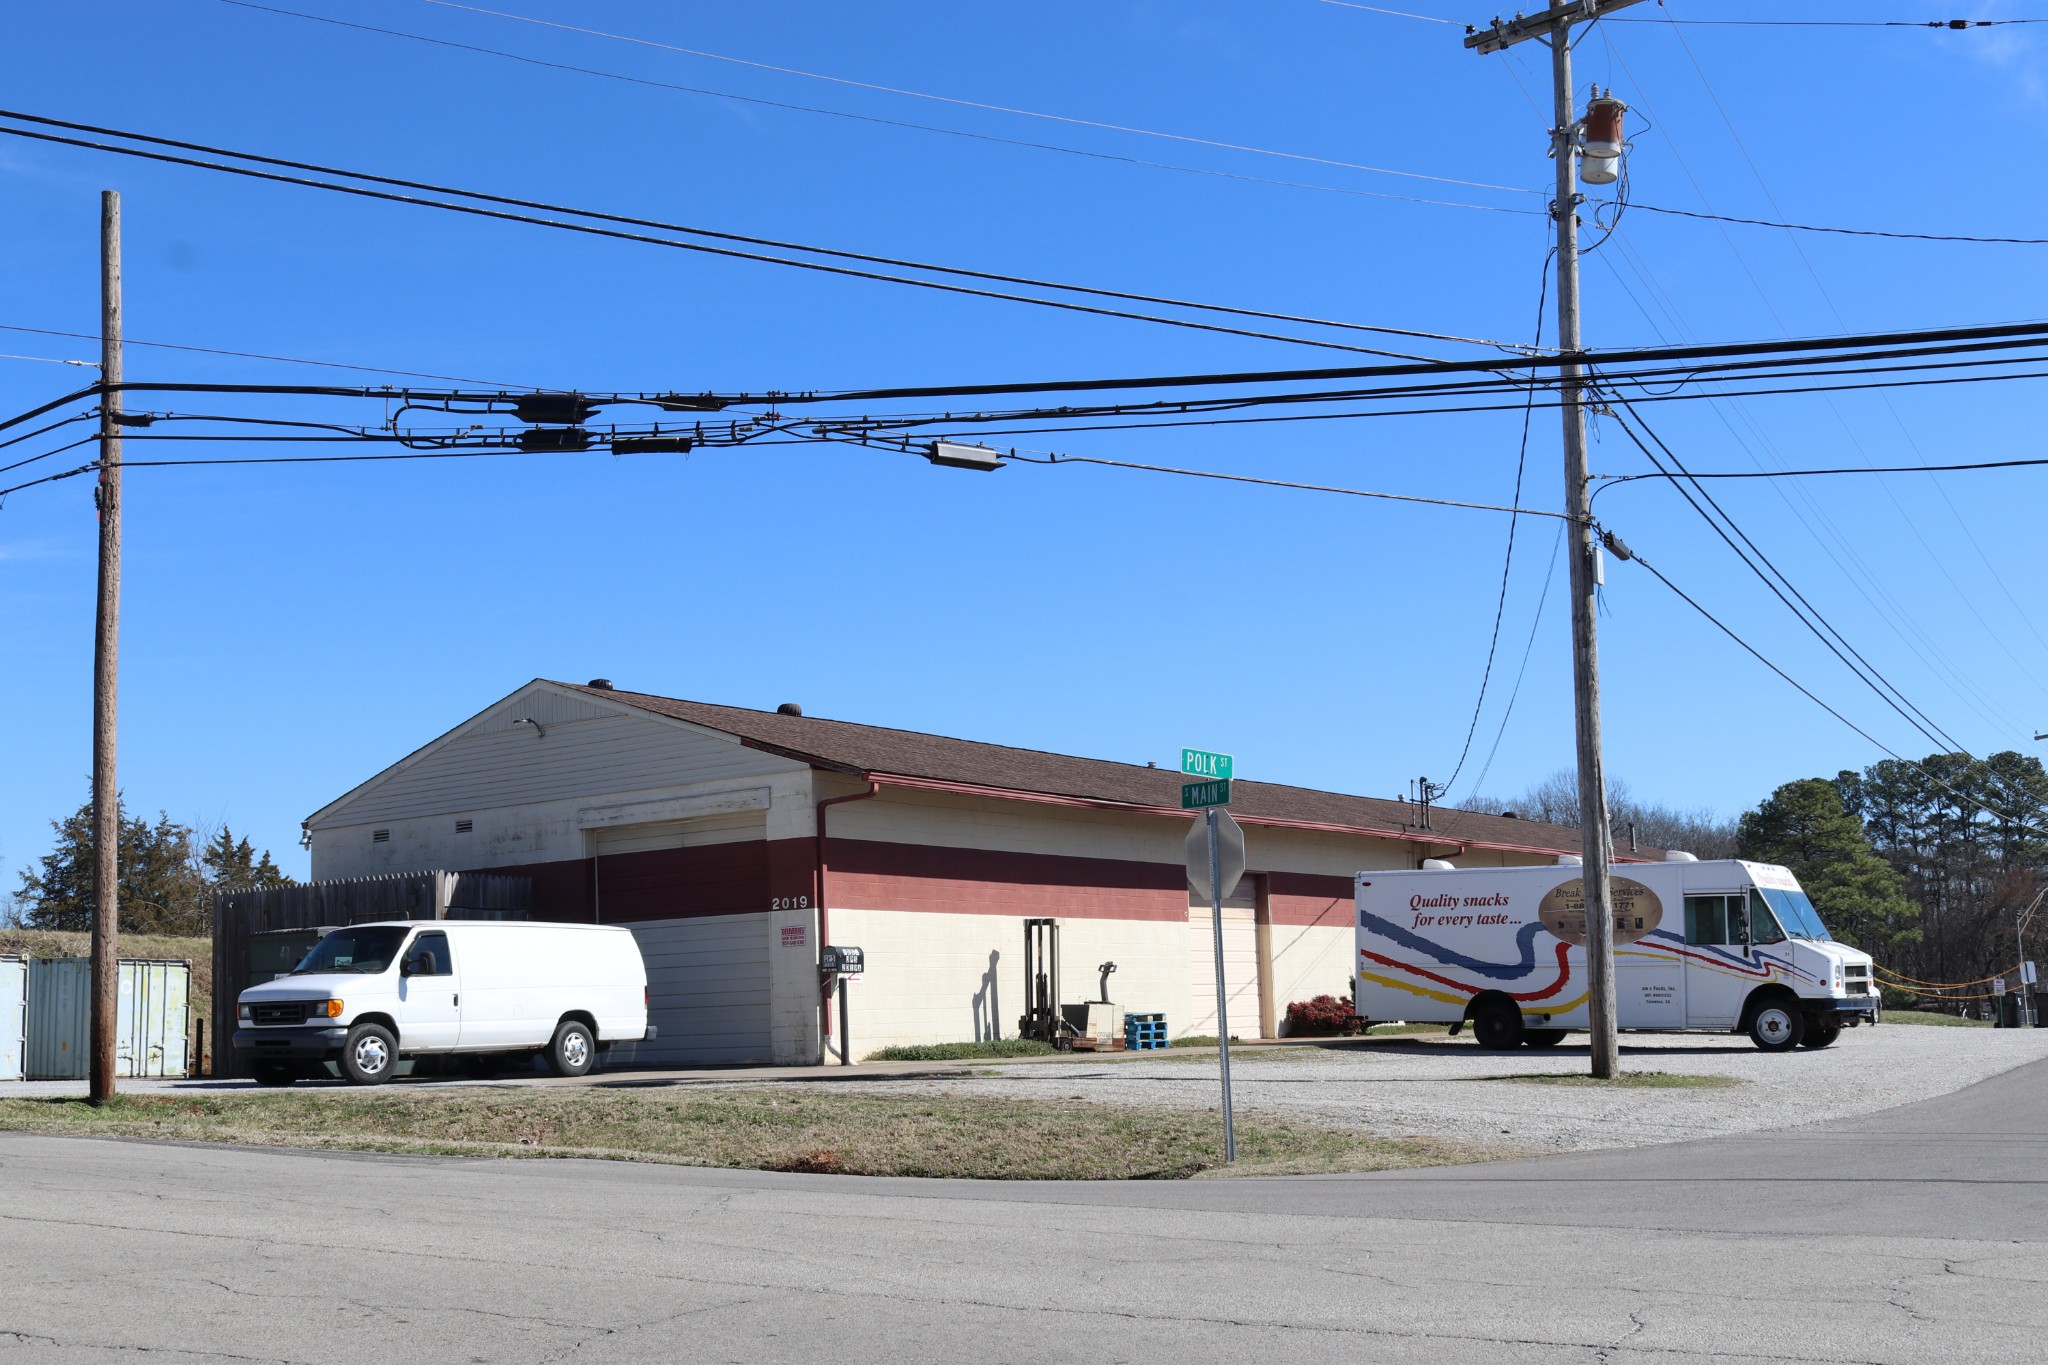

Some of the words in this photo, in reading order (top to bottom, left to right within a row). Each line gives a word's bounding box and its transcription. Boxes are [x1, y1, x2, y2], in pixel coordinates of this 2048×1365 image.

[1186, 751, 1217, 775] POLK
[1220, 757, 1228, 768] ST
[1184, 787, 1189, 797] S
[1191, 783, 1218, 806] MAIN
[1220, 782, 1227, 793] ST
[1554, 887, 1582, 898] Break
[1609, 886, 1645, 897] Services
[772, 895, 808, 910] 2019
[1409, 894, 1460, 911] Quality
[1463, 893, 1510, 907] snacks
[1411, 912, 1435, 930] for
[1437, 915, 1474, 929] every
